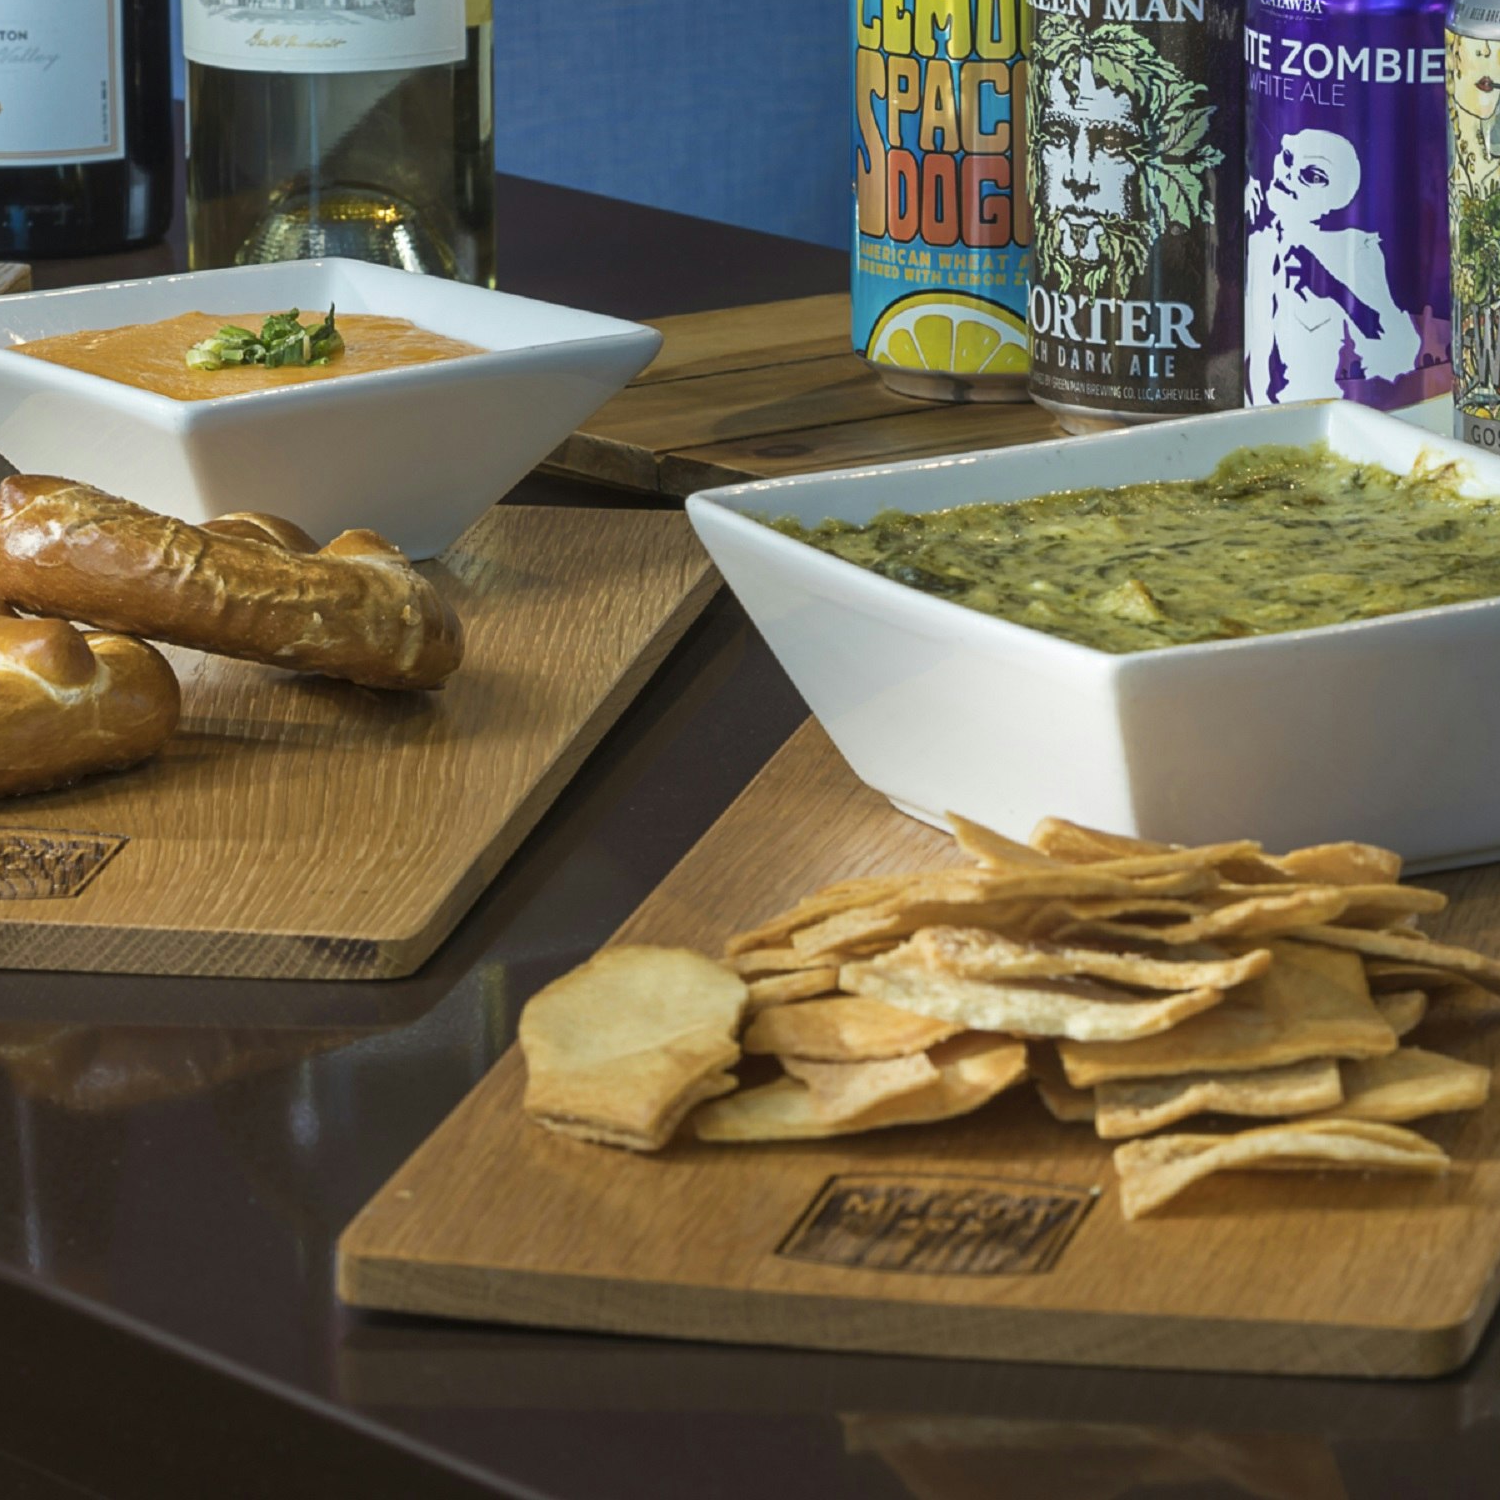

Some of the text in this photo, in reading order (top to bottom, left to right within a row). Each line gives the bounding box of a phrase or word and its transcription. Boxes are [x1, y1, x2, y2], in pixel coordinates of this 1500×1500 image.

[1244, 24, 1446, 84] ITE ZOMBIE
[1250, 73, 1346, 107] WHITE ALE
[887, 150, 1011, 247] DOG
[861, 241, 931, 268] AMERICAN
[938, 252, 1010, 271] WHEAT
[904, 268, 942, 285] WITH
[948, 271, 1007, 286] LEMON
[1035, 338, 1176, 378] CH DARK ALE
[1204, 388, 1216, 400] NC
